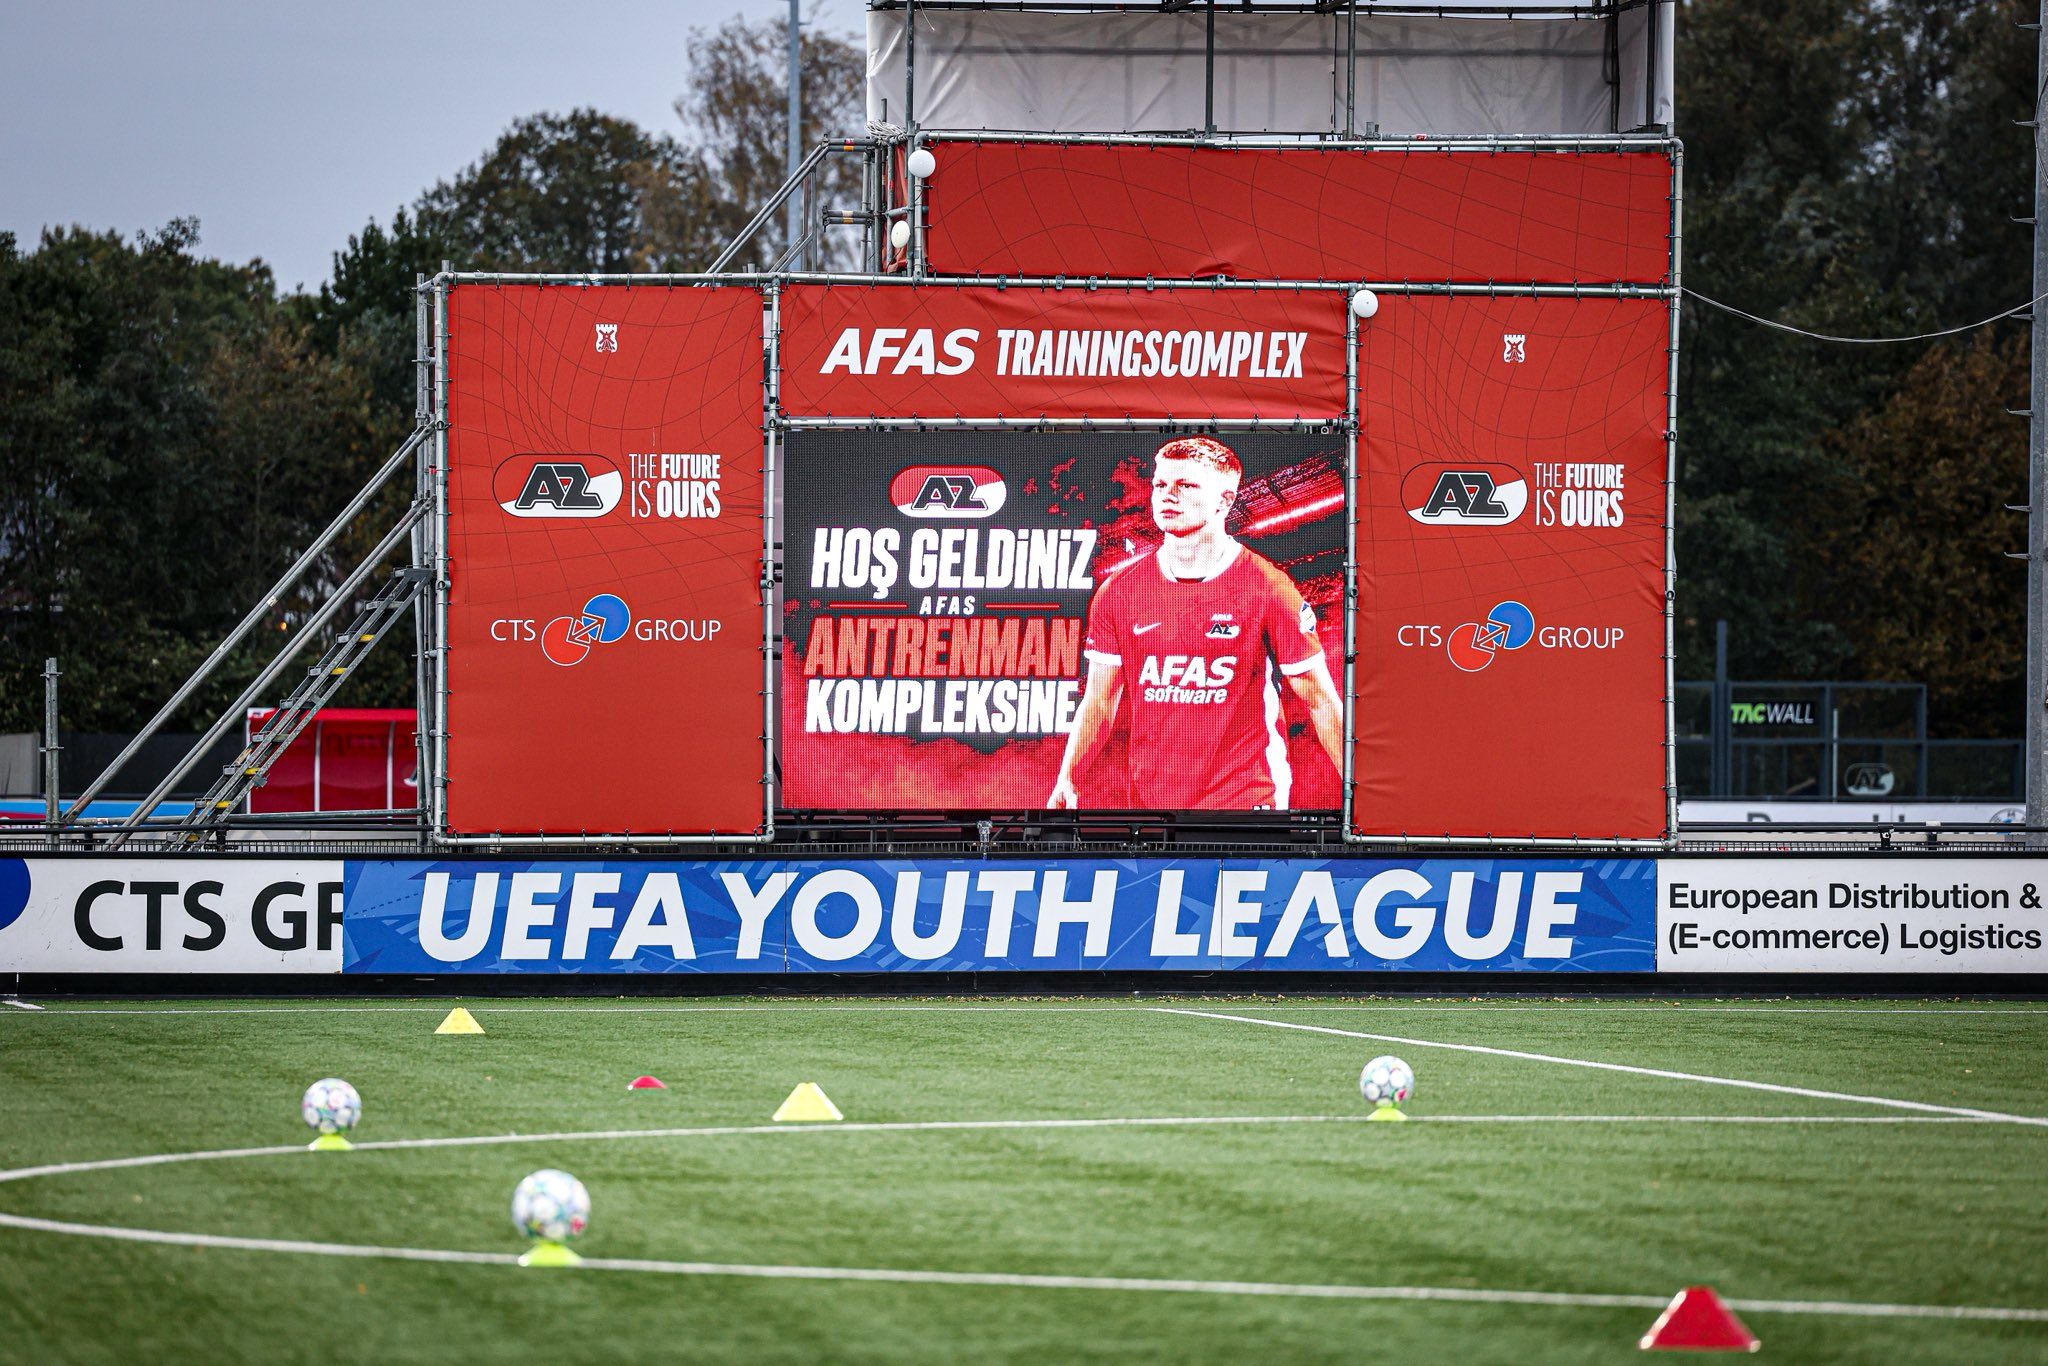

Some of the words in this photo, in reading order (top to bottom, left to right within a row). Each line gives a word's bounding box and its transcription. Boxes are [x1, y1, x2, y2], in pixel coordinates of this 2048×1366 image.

[819, 328, 980, 376] AFAS
[995, 329, 1309, 379] TRAININGSCOMPLEX
[629, 453, 658, 479] THE
[661, 454, 720, 479] FUTURE
[1534, 462, 1562, 487] THE
[1565, 463, 1625, 489] FUTURE
[515, 462, 603, 510] AZ
[631, 480, 652, 518] IS
[656, 481, 720, 518] OURS
[911, 474, 988, 511] AZ
[1422, 470, 1509, 518] AZ
[1535, 489, 1555, 527] IS
[1560, 490, 1625, 528] OURS
[811, 527, 900, 600] HOŞ
[920, 595, 976, 615] AFAS
[490, 618, 536, 642] CTS
[634, 619, 722, 642] GROUP
[803, 617, 1081, 677] ANTRENMAN
[1397, 624, 1442, 648] CTS
[1538, 626, 1625, 649] GROUP
[1139, 655, 1238, 687] AFAS
[1144, 685, 1228, 705] software
[73, 880, 227, 952] CTS
[418, 871, 697, 962] UEFA
[719, 869, 1119, 961] YOUTH
[1149, 869, 1584, 961] LEAGUE
[1668, 883, 1818, 914] European
[1829, 882, 2010, 909] Distribution
[2019, 882, 2043, 909] &
[1668, 922, 1890, 954] (E-commerce)
[1900, 923, 2042, 955] Logistics
